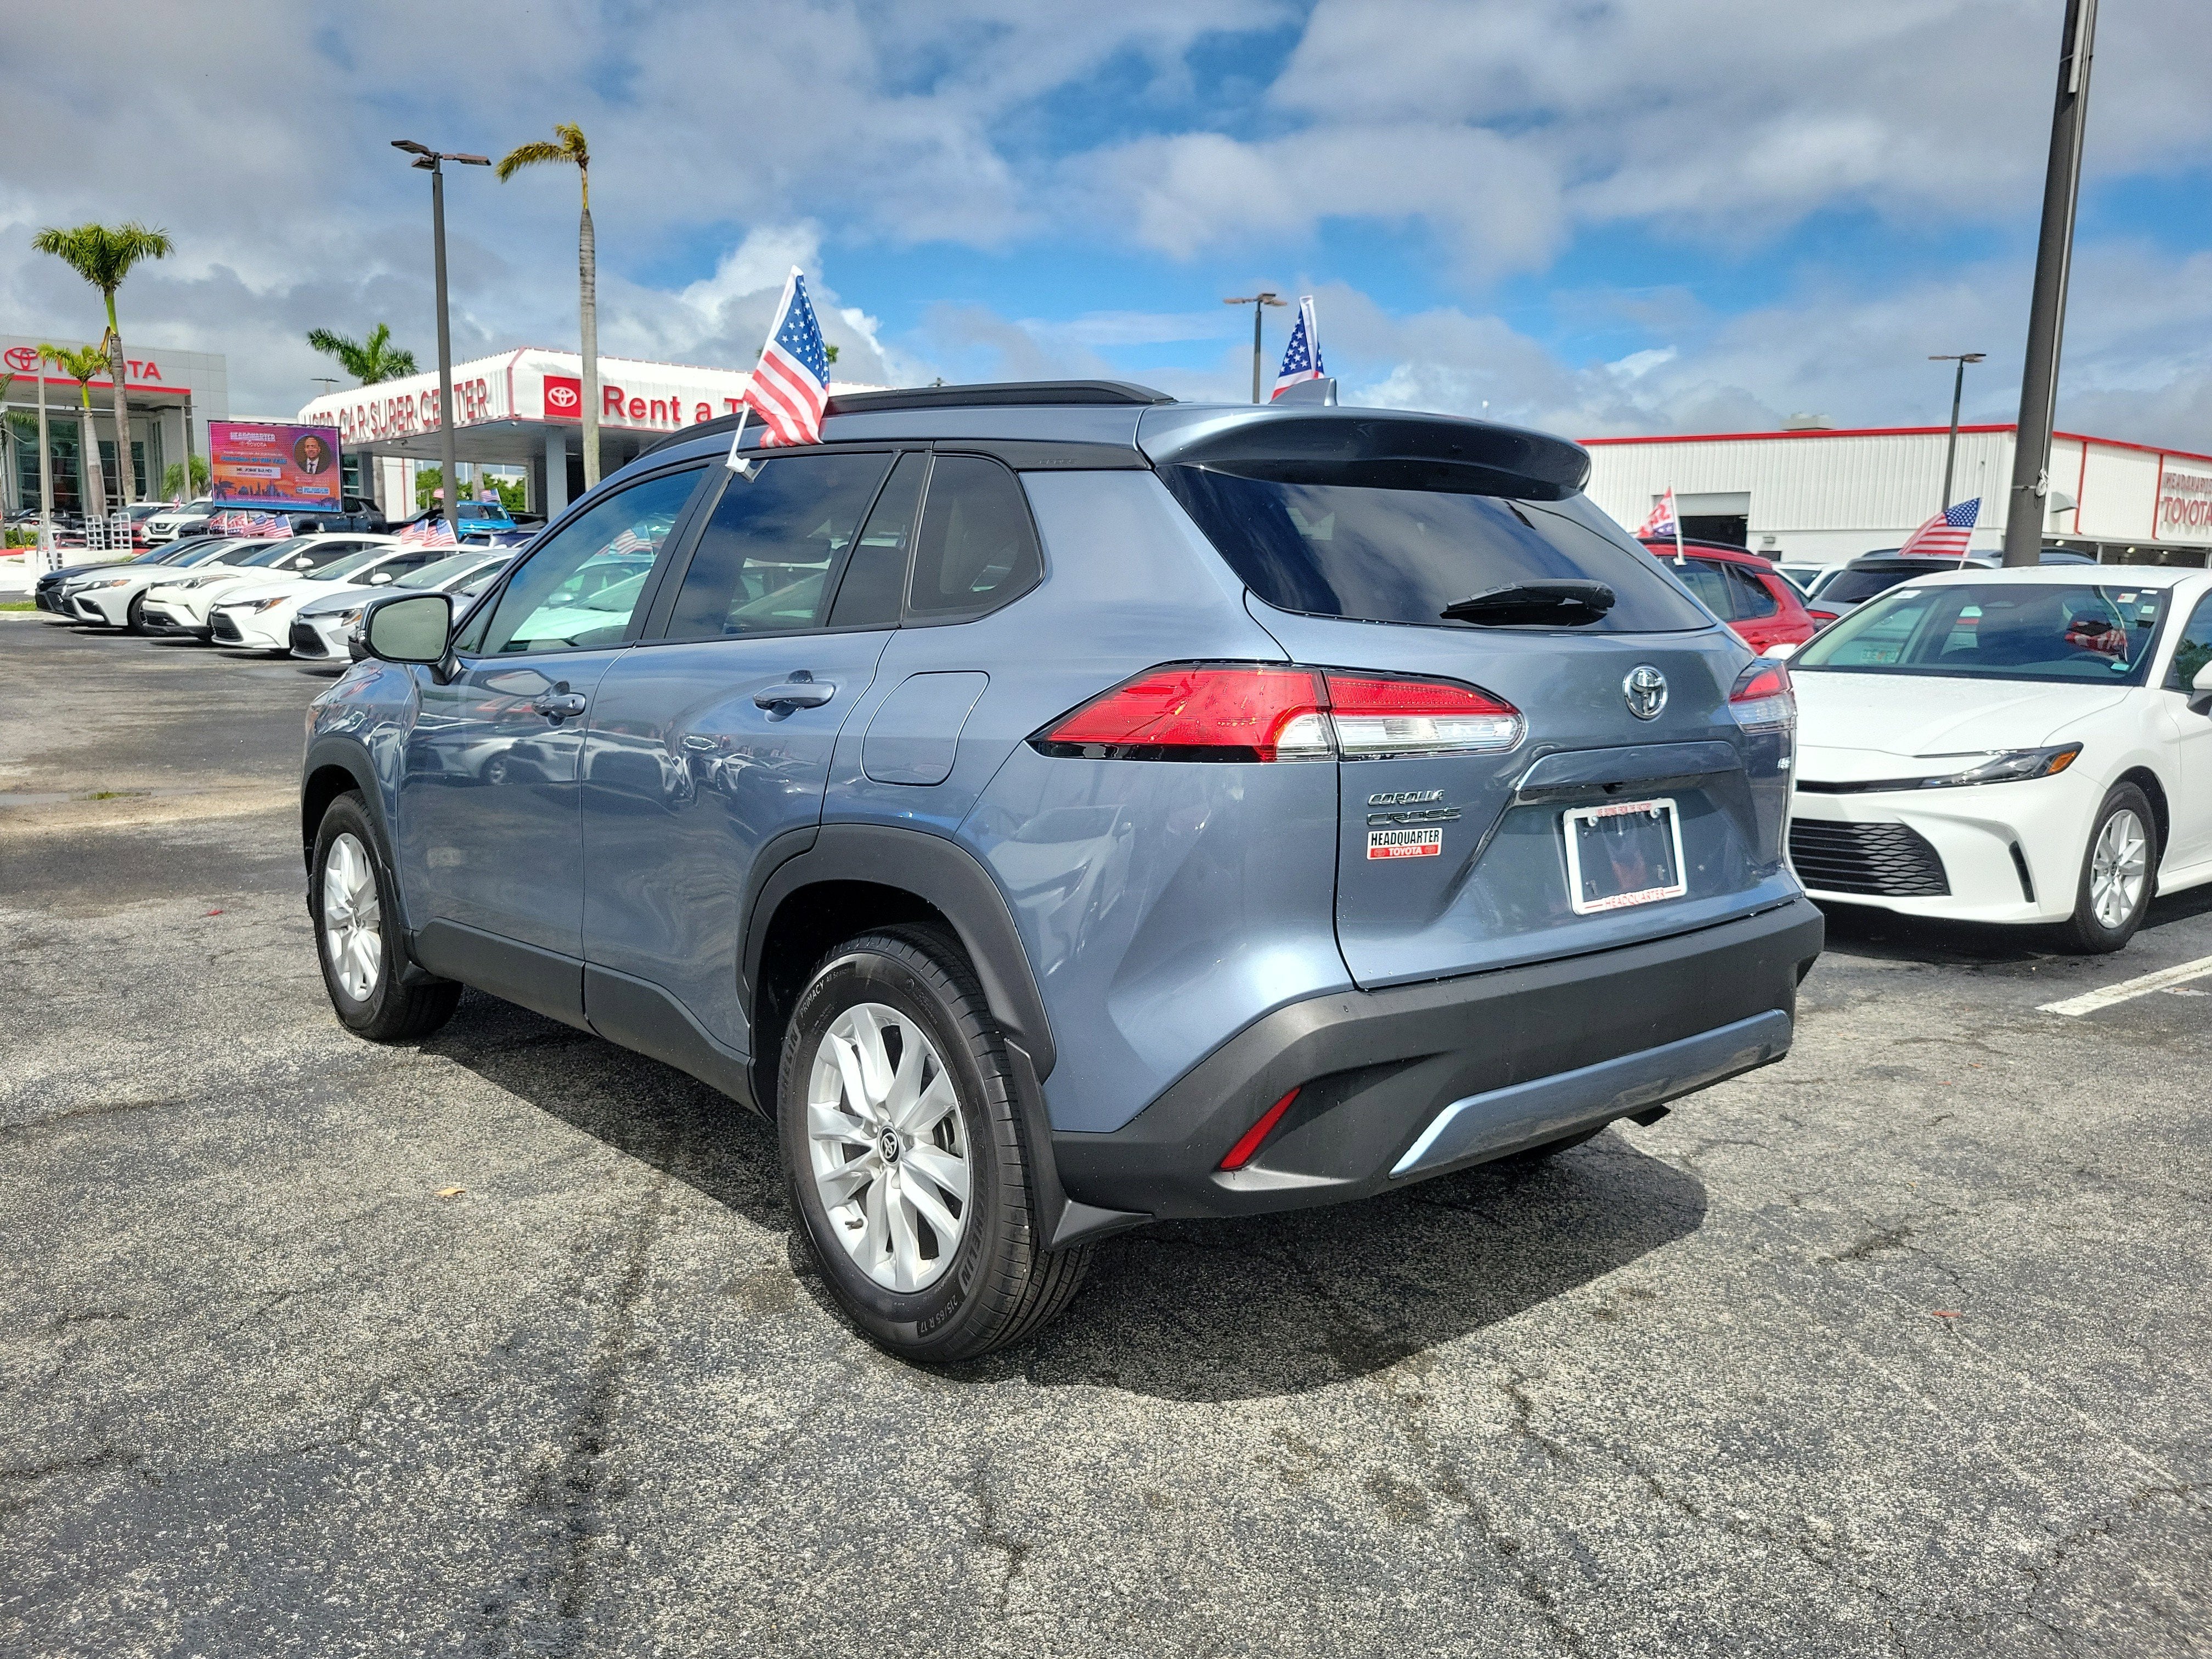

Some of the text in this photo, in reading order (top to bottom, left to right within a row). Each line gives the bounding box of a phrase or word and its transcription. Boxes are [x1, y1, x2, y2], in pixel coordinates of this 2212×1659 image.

[340, 378, 488, 439] CAR SUPER CETER
[603, 385, 681, 422] Rent
[695, 402, 712, 424] a
[2164, 496, 2212, 526] TOYOTA
[1368, 789, 1445, 805] COROLLA
[1367, 806, 1462, 826] CROSS
[1371, 830, 1440, 846] HEADQUARTER
[1388, 846, 1423, 856] TOYOTA
[1605, 889, 1666, 909] HEADQUARTER
[800, 979, 825, 1018] PRIMACY
[921, 1295, 958, 1332] 215/65 R 17
